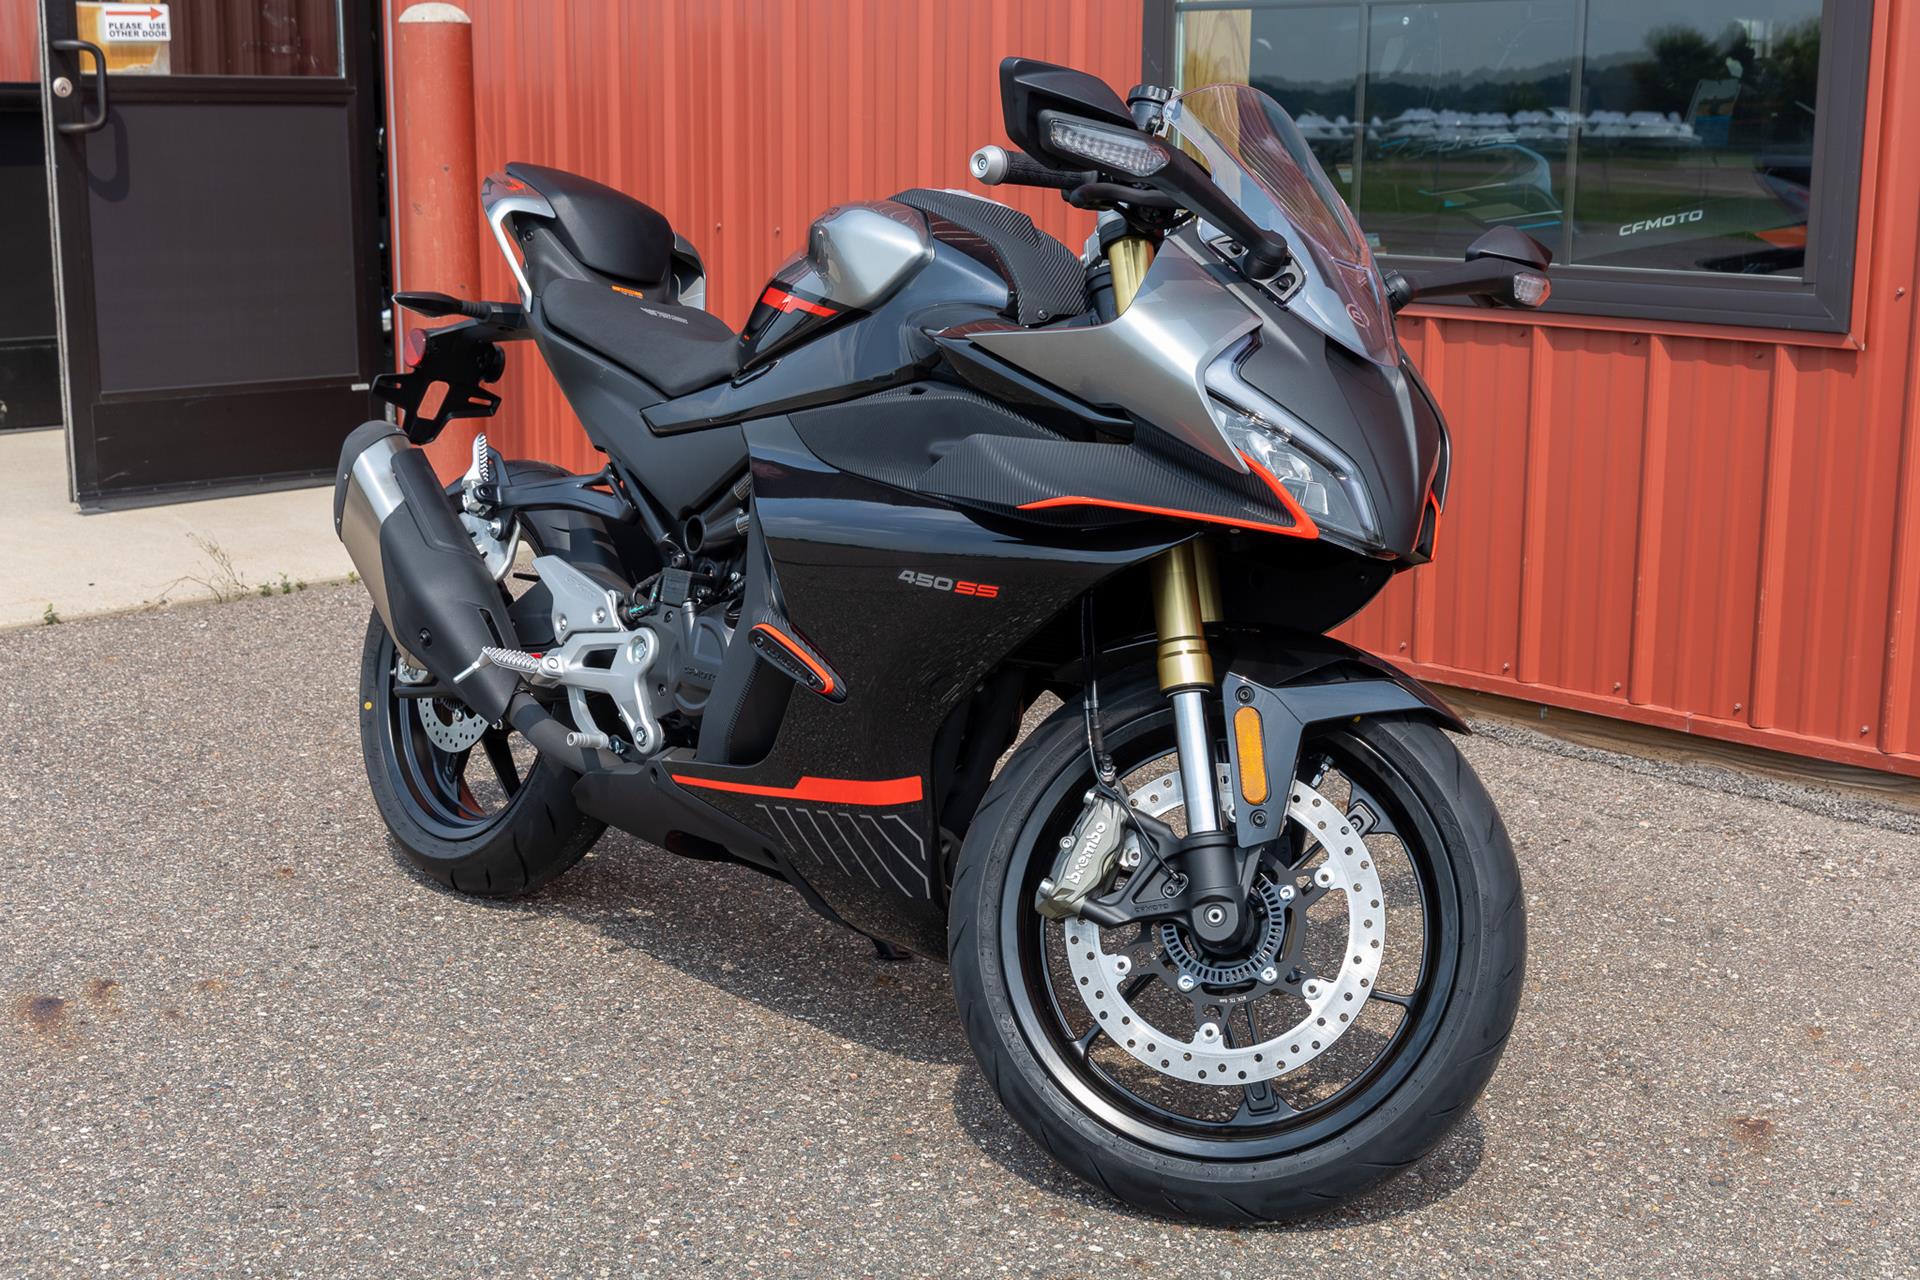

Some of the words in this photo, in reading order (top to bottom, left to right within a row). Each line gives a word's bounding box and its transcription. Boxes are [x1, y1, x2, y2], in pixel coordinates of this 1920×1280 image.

[108, 22, 143, 30] PLEASE
[149, 22, 166, 30] USE
[1618, 209, 1704, 236] CFMOTO
[1066, 822, 1106, 884] brembo
